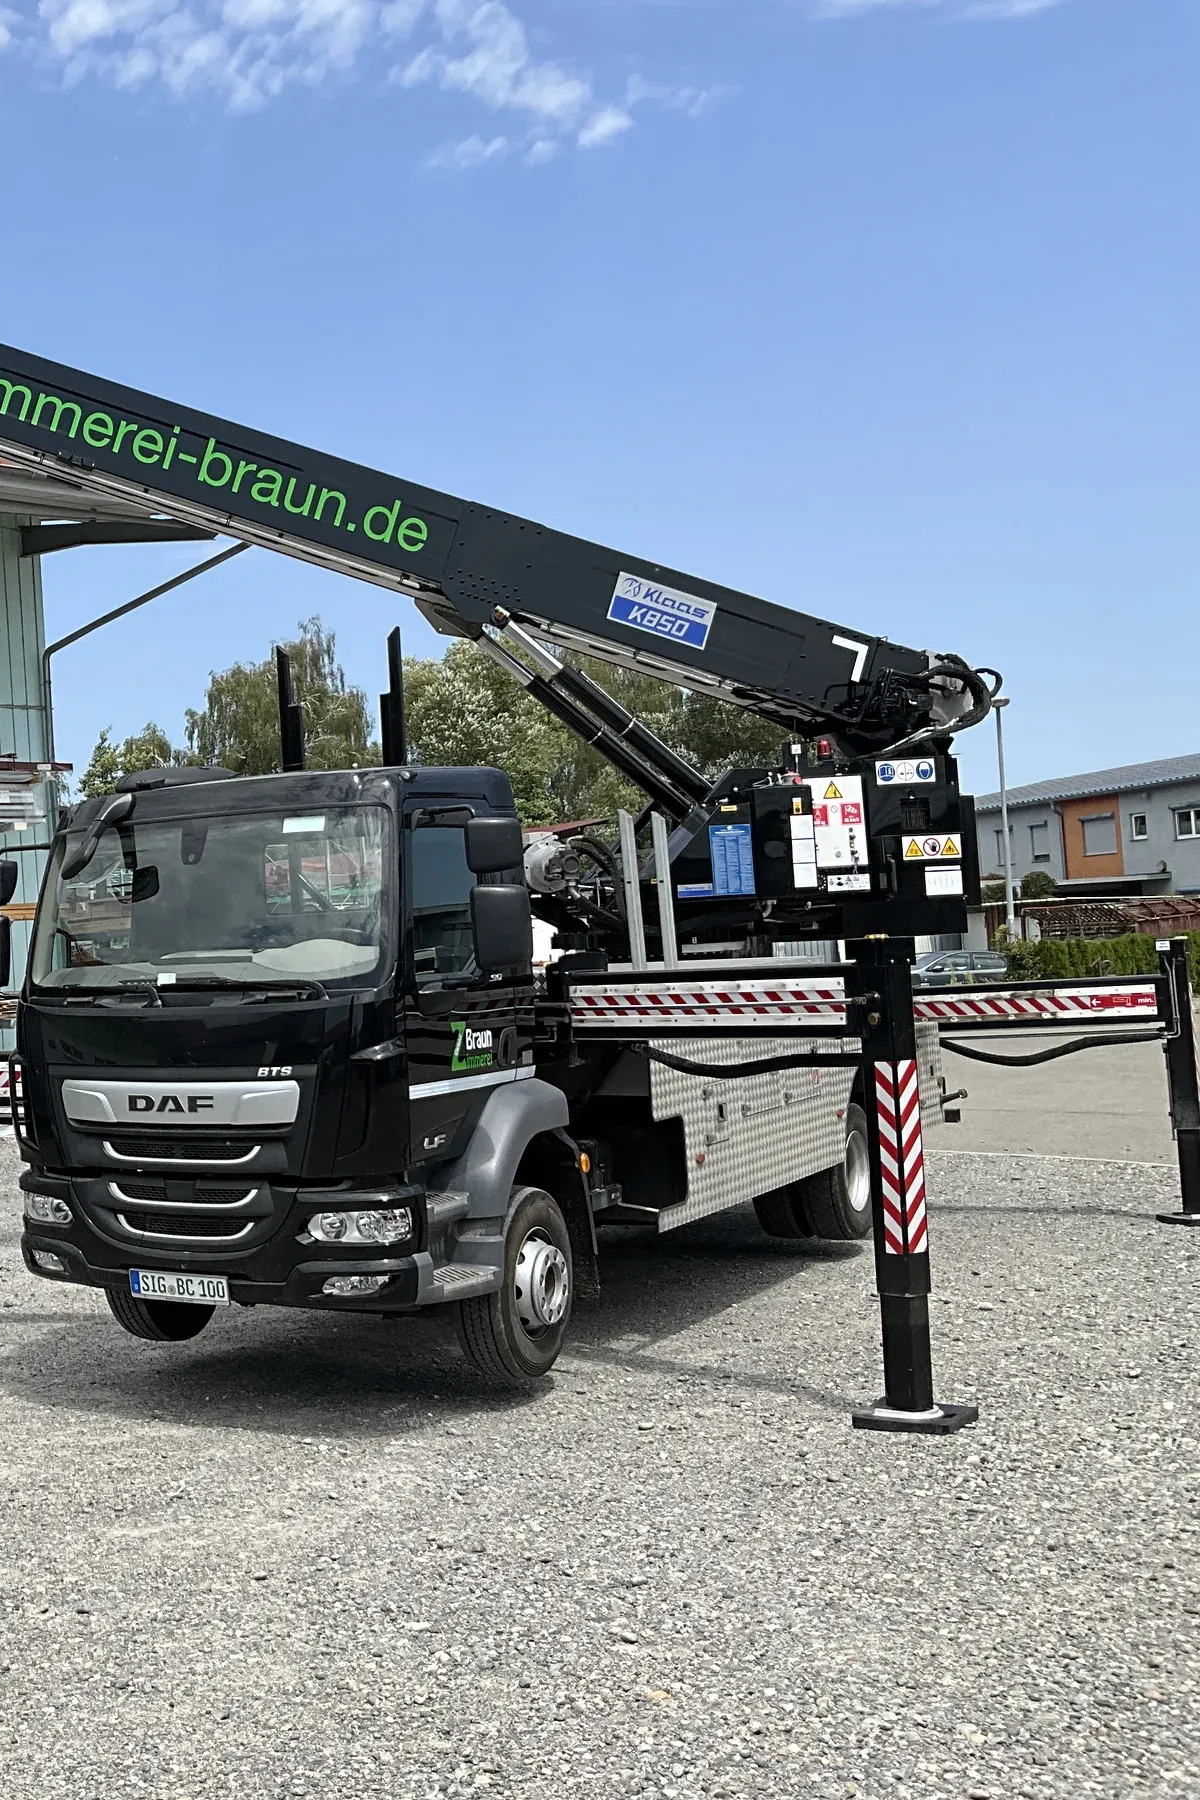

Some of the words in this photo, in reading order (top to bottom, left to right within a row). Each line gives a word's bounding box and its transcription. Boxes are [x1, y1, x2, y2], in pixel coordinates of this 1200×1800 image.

[643, 587, 710, 619] Klaas
[628, 605, 690, 637] K850
[1137, 996, 1154, 1004] min.
[465, 1028, 493, 1050] Braun
[257, 1066, 293, 1077] BTS
[127, 1094, 214, 1113] DAF
[423, 1133, 447, 1150] LF
[141, 1274, 167, 1293] SIG
[176, 1277, 195, 1296] BC
[198, 1279, 226, 1298] 100
